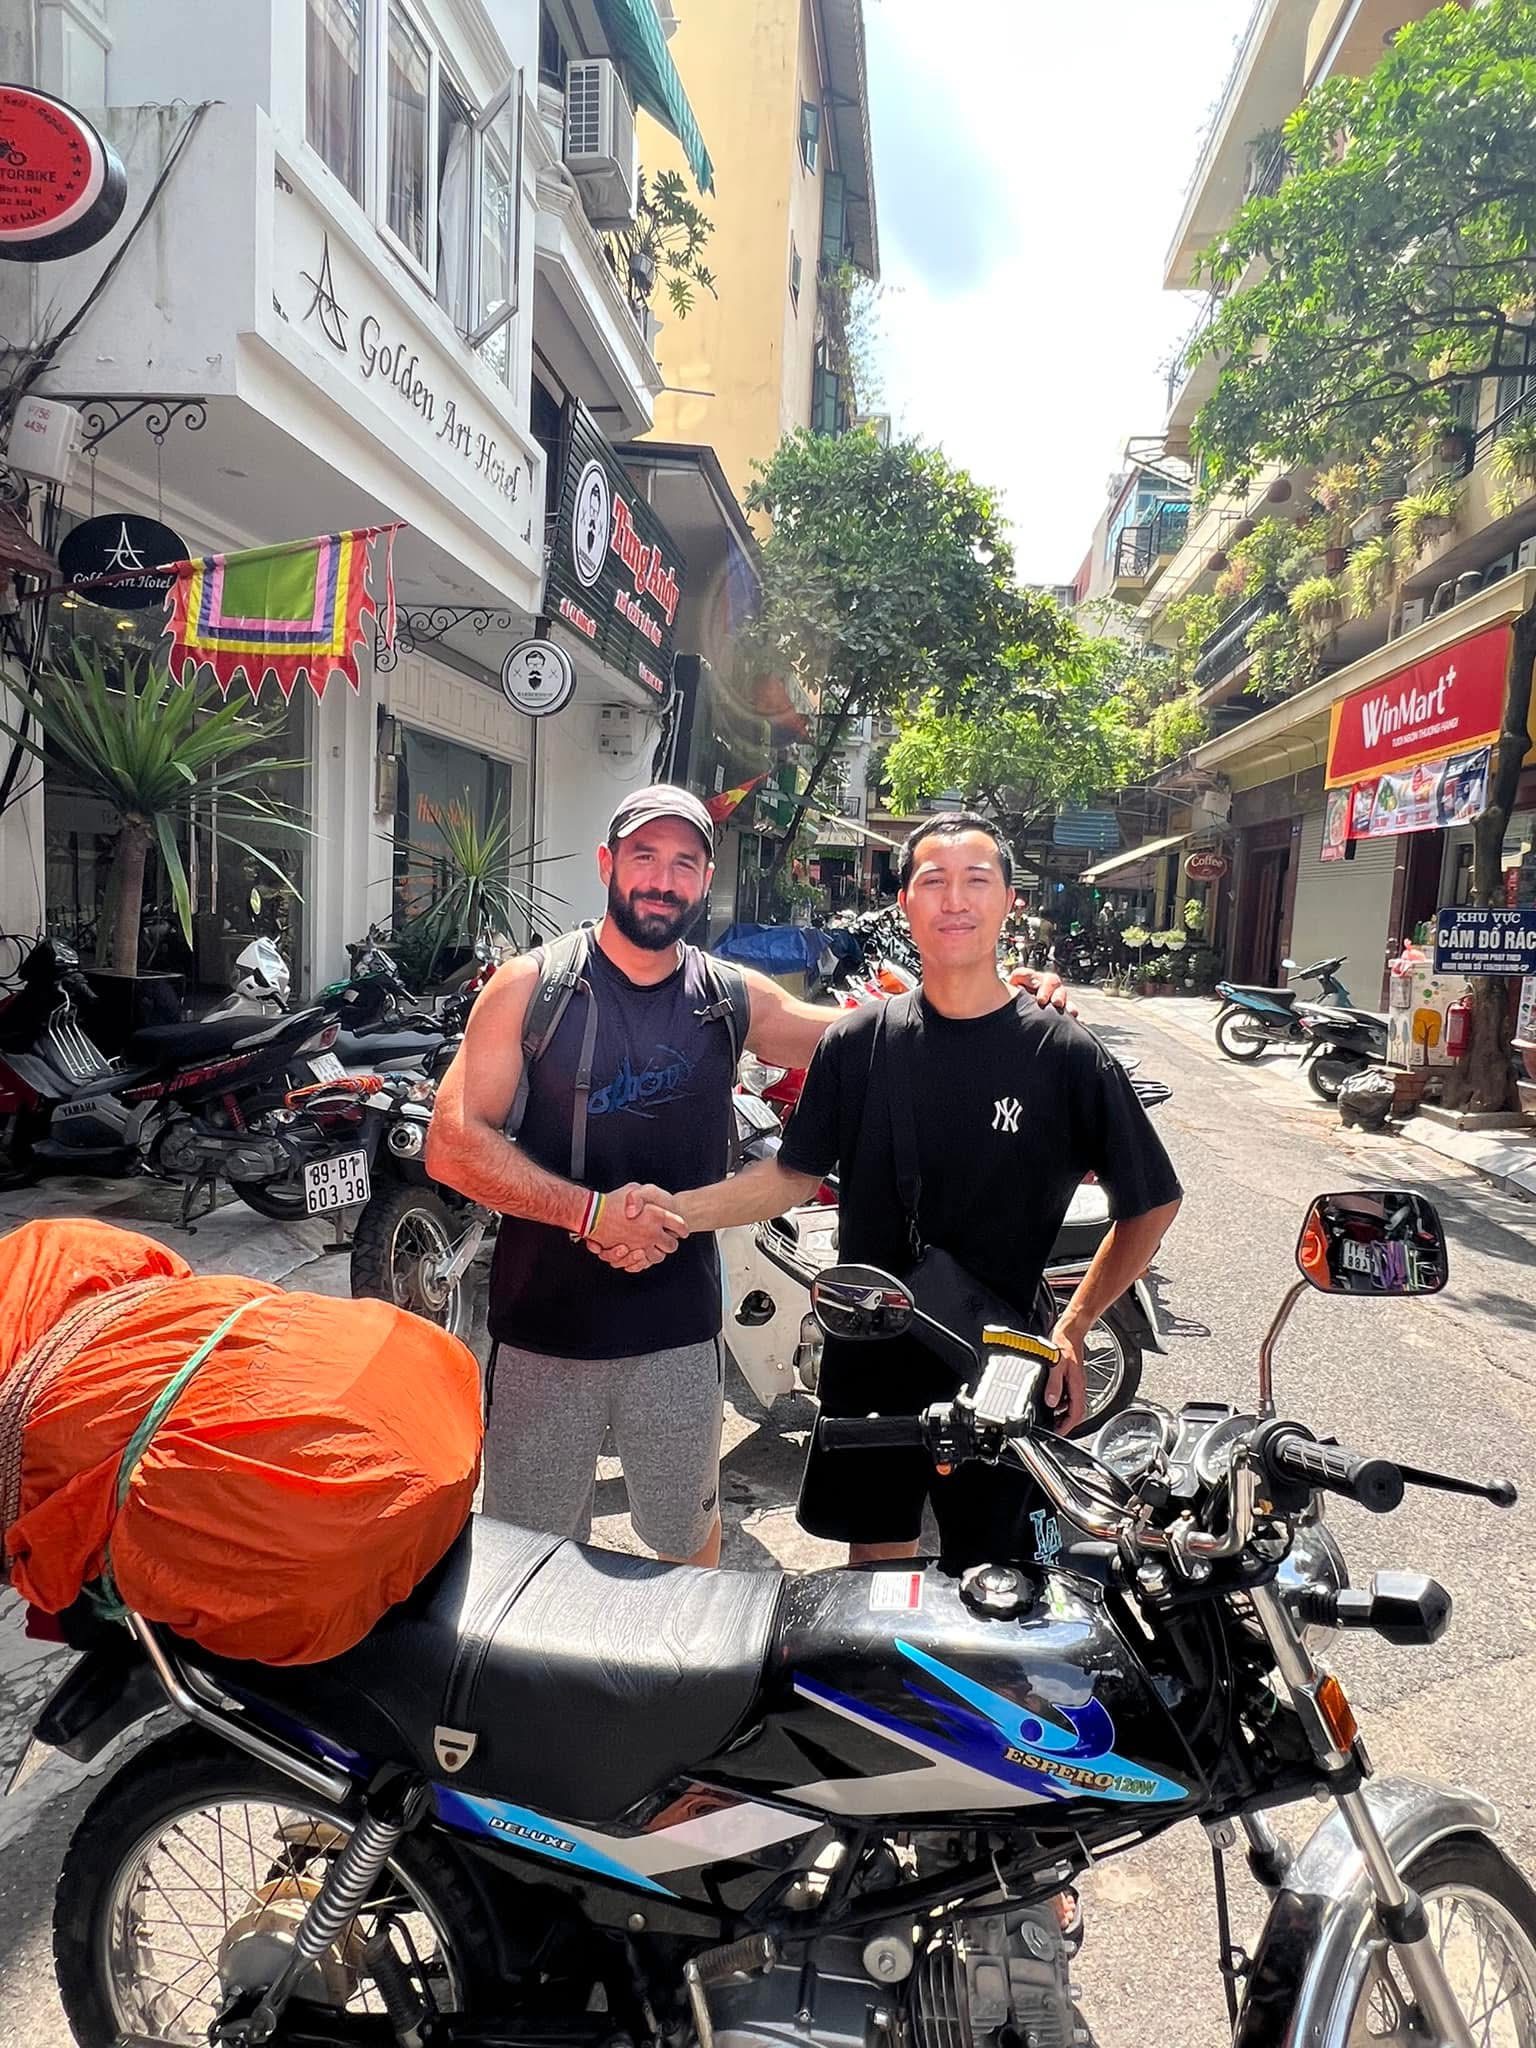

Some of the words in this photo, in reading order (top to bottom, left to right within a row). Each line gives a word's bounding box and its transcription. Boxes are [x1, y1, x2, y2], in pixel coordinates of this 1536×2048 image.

[361, 315, 434, 422] Golden
[437, 400, 472, 457] Art
[475, 433, 521, 502] Hotel
[136, 575, 173, 589] Hotel
[1191, 855, 1223, 867] Coffee
[1456, 912, 1488, 923] KHU
[1492, 912, 1521, 926] VỰC
[1439, 923, 1475, 948] CẤM
[1478, 923, 1501, 949] ĐỔ
[1504, 927, 1536, 950] RÁC
[63, 1102, 97, 1117] YAMAHA
[991, 1096, 1023, 1133] NY
[312, 1156, 358, 1186] 89-B1
[308, 1178, 365, 1211] 603.38
[1003, 1747, 1114, 1791] ESPERO
[488, 1816, 577, 1853] DELUXE
